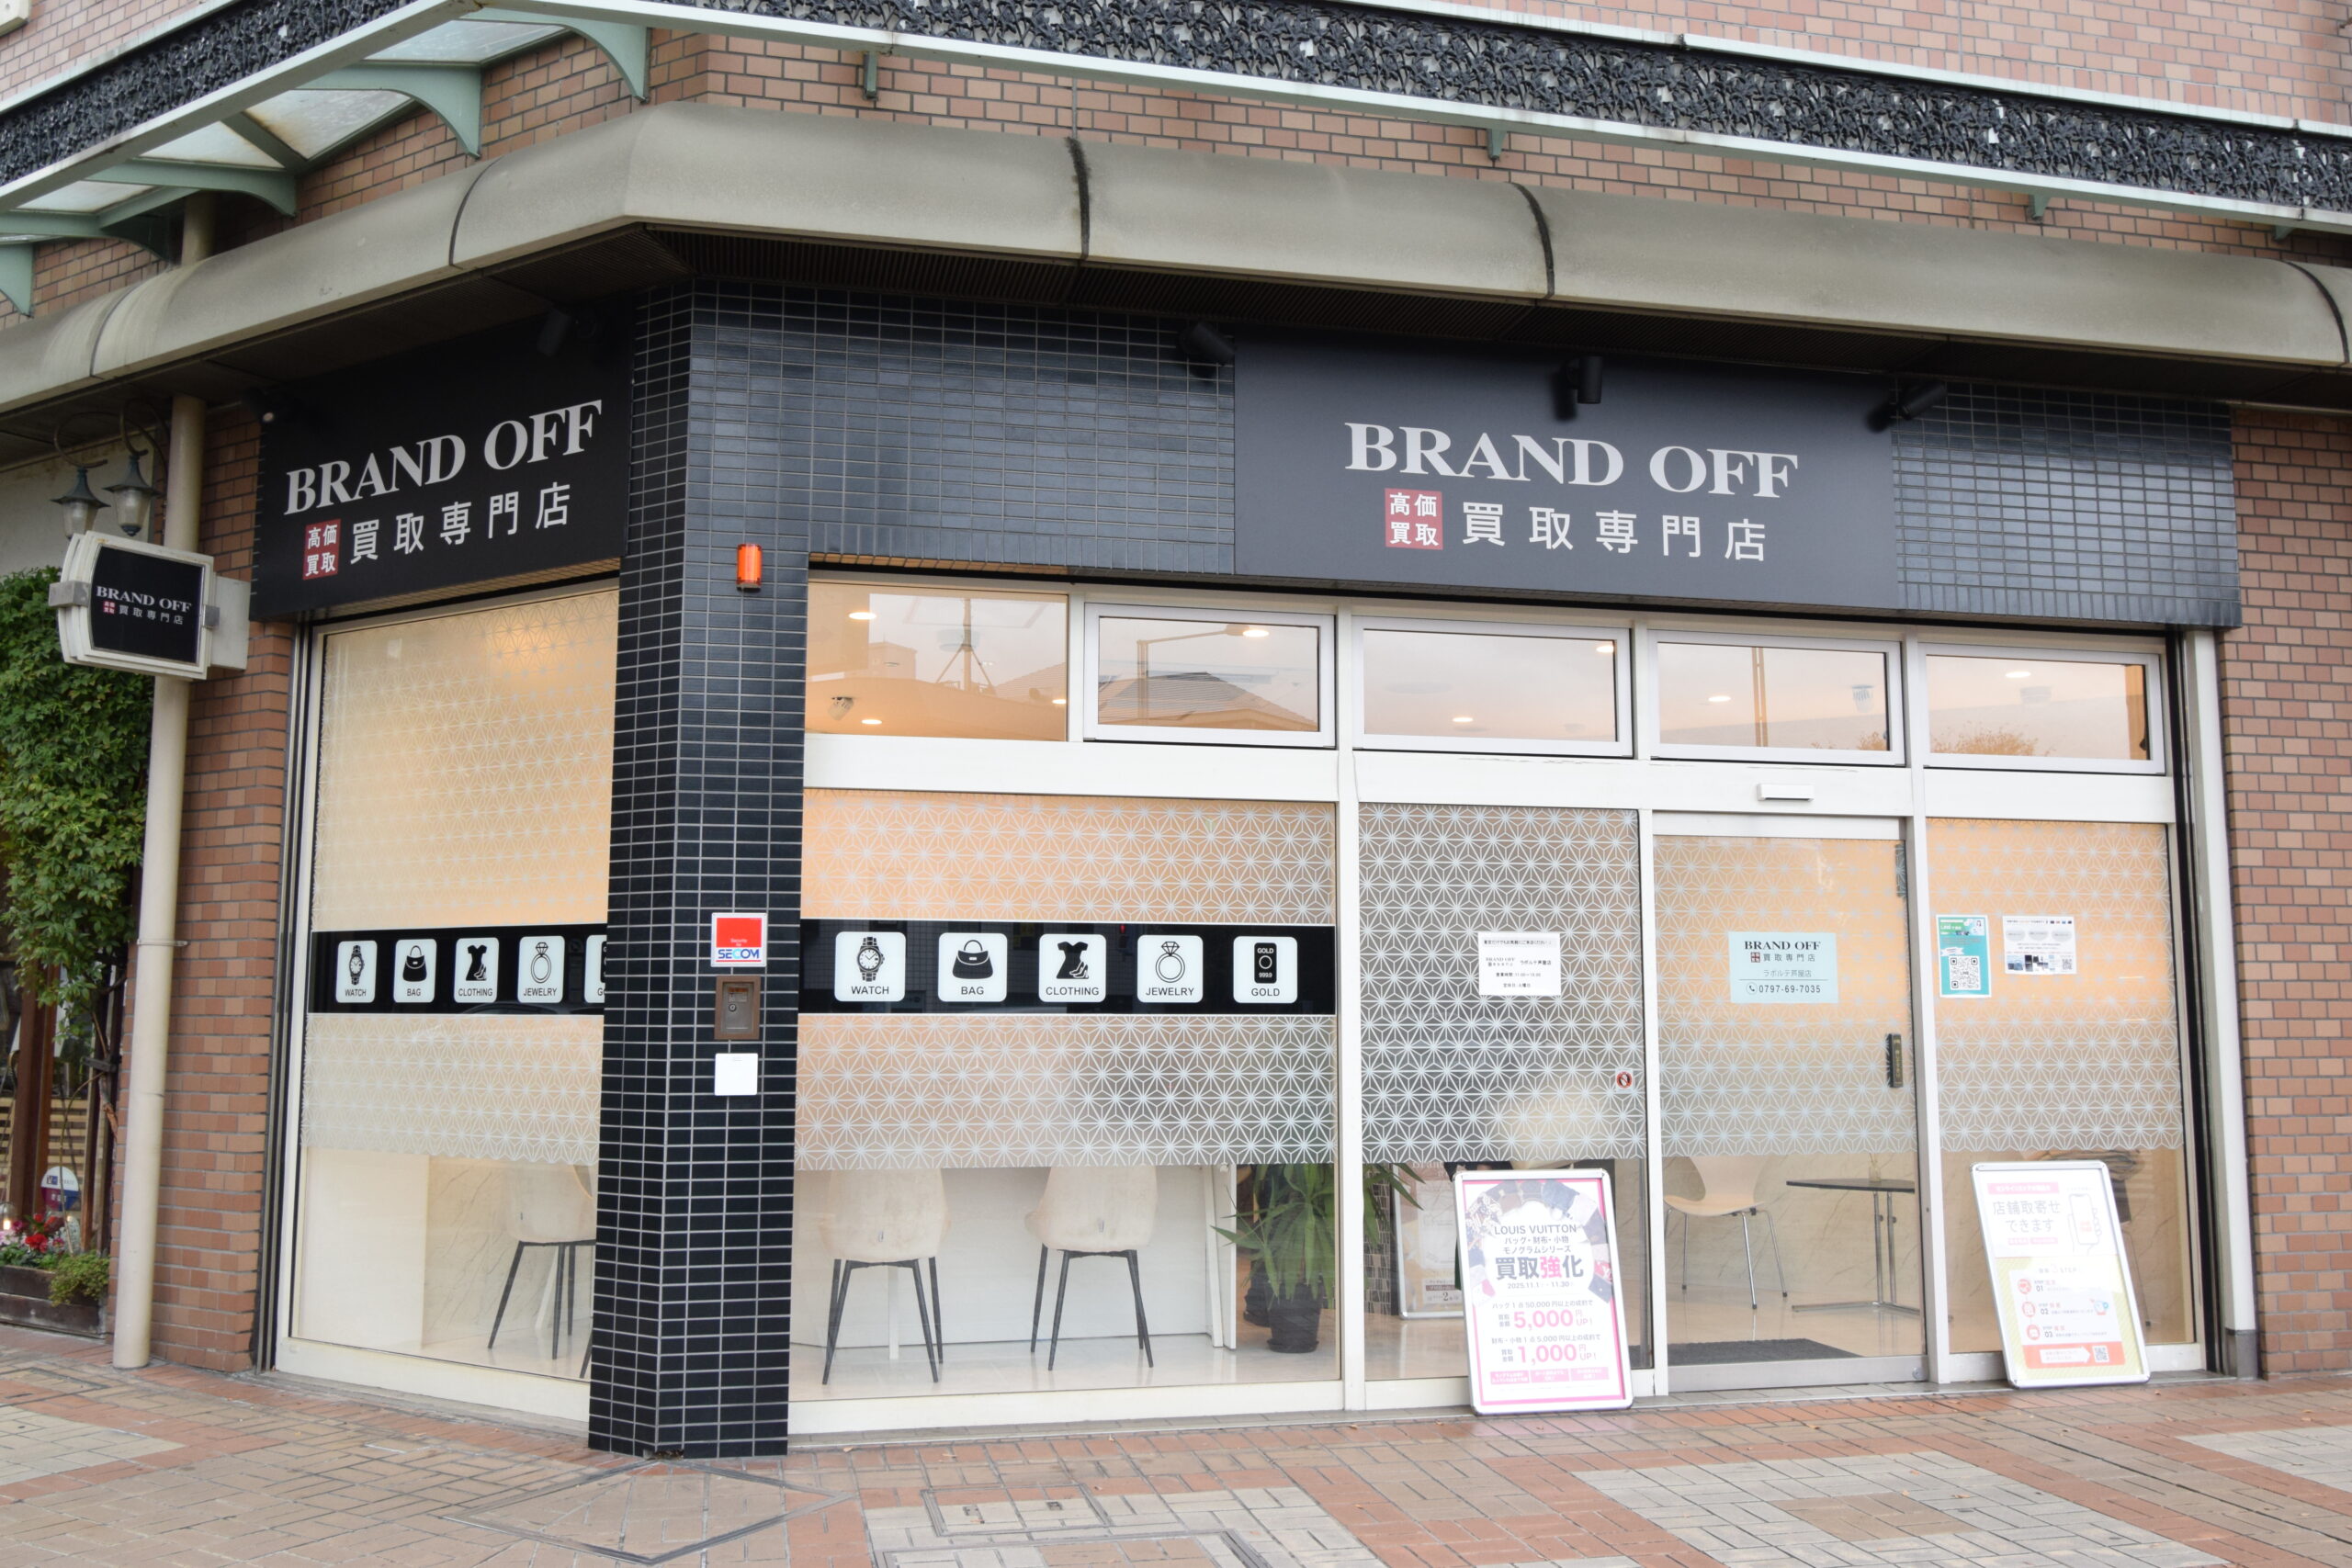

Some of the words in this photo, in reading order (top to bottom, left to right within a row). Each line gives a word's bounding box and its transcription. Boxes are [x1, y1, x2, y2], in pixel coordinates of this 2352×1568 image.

[284, 434, 466, 515] BRAND
[484, 400, 603, 470] OFF
[1344, 422, 1624, 486] BRAND
[1649, 446, 1799, 498] OFF
[1389, 491, 1438, 518] 高価
[350, 481, 571, 565] 買取専門店
[308, 523, 338, 550] 高価
[1389, 521, 1440, 547] 買取
[1462, 501, 1767, 562] 買取専門店
[305, 552, 335, 577] 買取
[96, 585, 155, 606] BRAND
[159, 598, 192, 613] OFF
[119, 604, 184, 625] 買取専門店
[1744, 941, 1791, 950] BRAND
[1794, 941, 1821, 950] OFF
[718, 948, 760, 959] SECOM
[1762, 953, 1815, 962] 買取専門店
[345, 988, 367, 997] WATCH
[406, 988, 422, 997] BAG
[458, 987, 493, 997] CLOTHING
[523, 987, 558, 997] JEWELRY
[851, 986, 889, 995] WATCH
[960, 986, 985, 995] BAG
[1046, 987, 1100, 996] CLOTHING
[1146, 987, 1194, 997] JEWELRY
[1250, 987, 1281, 997] GOLD
[1758, 985, 1821, 993] 0797-69-7035
[1993, 1200, 2062, 1215] 店舗取寄せ
[1494, 1225, 1526, 1235] LOUIS
[1529, 1224, 1577, 1234] VUITTON
[2005, 1218, 2054, 1233] できます
[1503, 1245, 1571, 1255] モノグラムシリーズ
[1495, 1255, 1584, 1280] 買取強化
[1513, 1309, 1574, 1331] 5,000
[1518, 1344, 1577, 1366] 1,000
